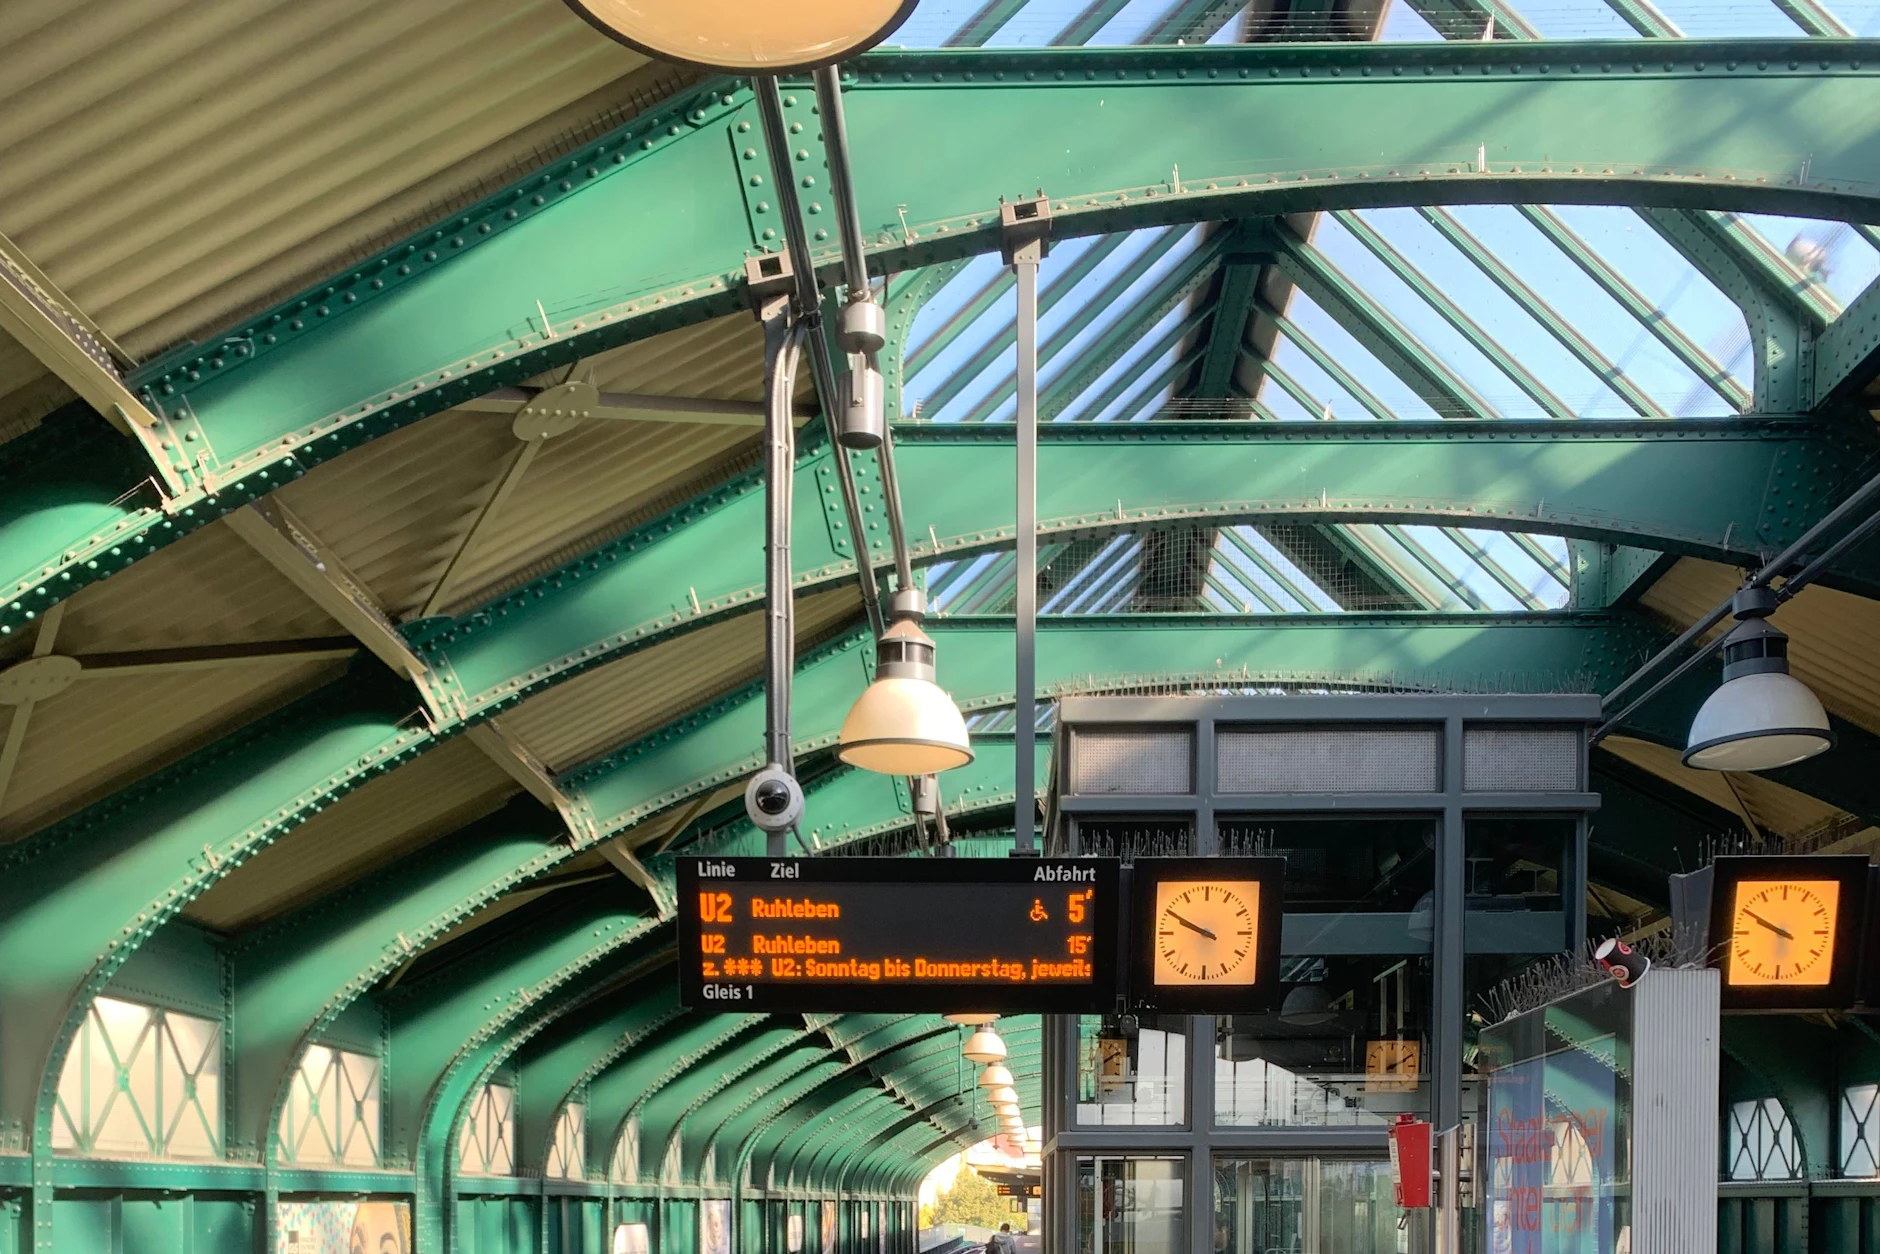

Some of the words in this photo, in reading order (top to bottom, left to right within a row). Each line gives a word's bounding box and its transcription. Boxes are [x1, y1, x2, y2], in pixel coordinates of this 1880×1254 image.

[697, 861, 736, 877] Linie
[770, 862, 799, 878] Ziel
[1033, 865, 1096, 882] Abfahrt
[699, 892, 733, 922] U2
[751, 898, 840, 918] Ruhleben
[700, 934, 726, 954] U2
[753, 935, 840, 954] Ruhleben
[771, 957, 802, 977] U2:
[805, 958, 881, 980] Sonntag
[884, 958, 911, 977] bis
[914, 958, 1027, 980] Donnerstag,
[702, 984, 741, 1000] Gleis
[745, 985, 753, 1000] 1
[1496, 1105, 1608, 1166] Staatsper
